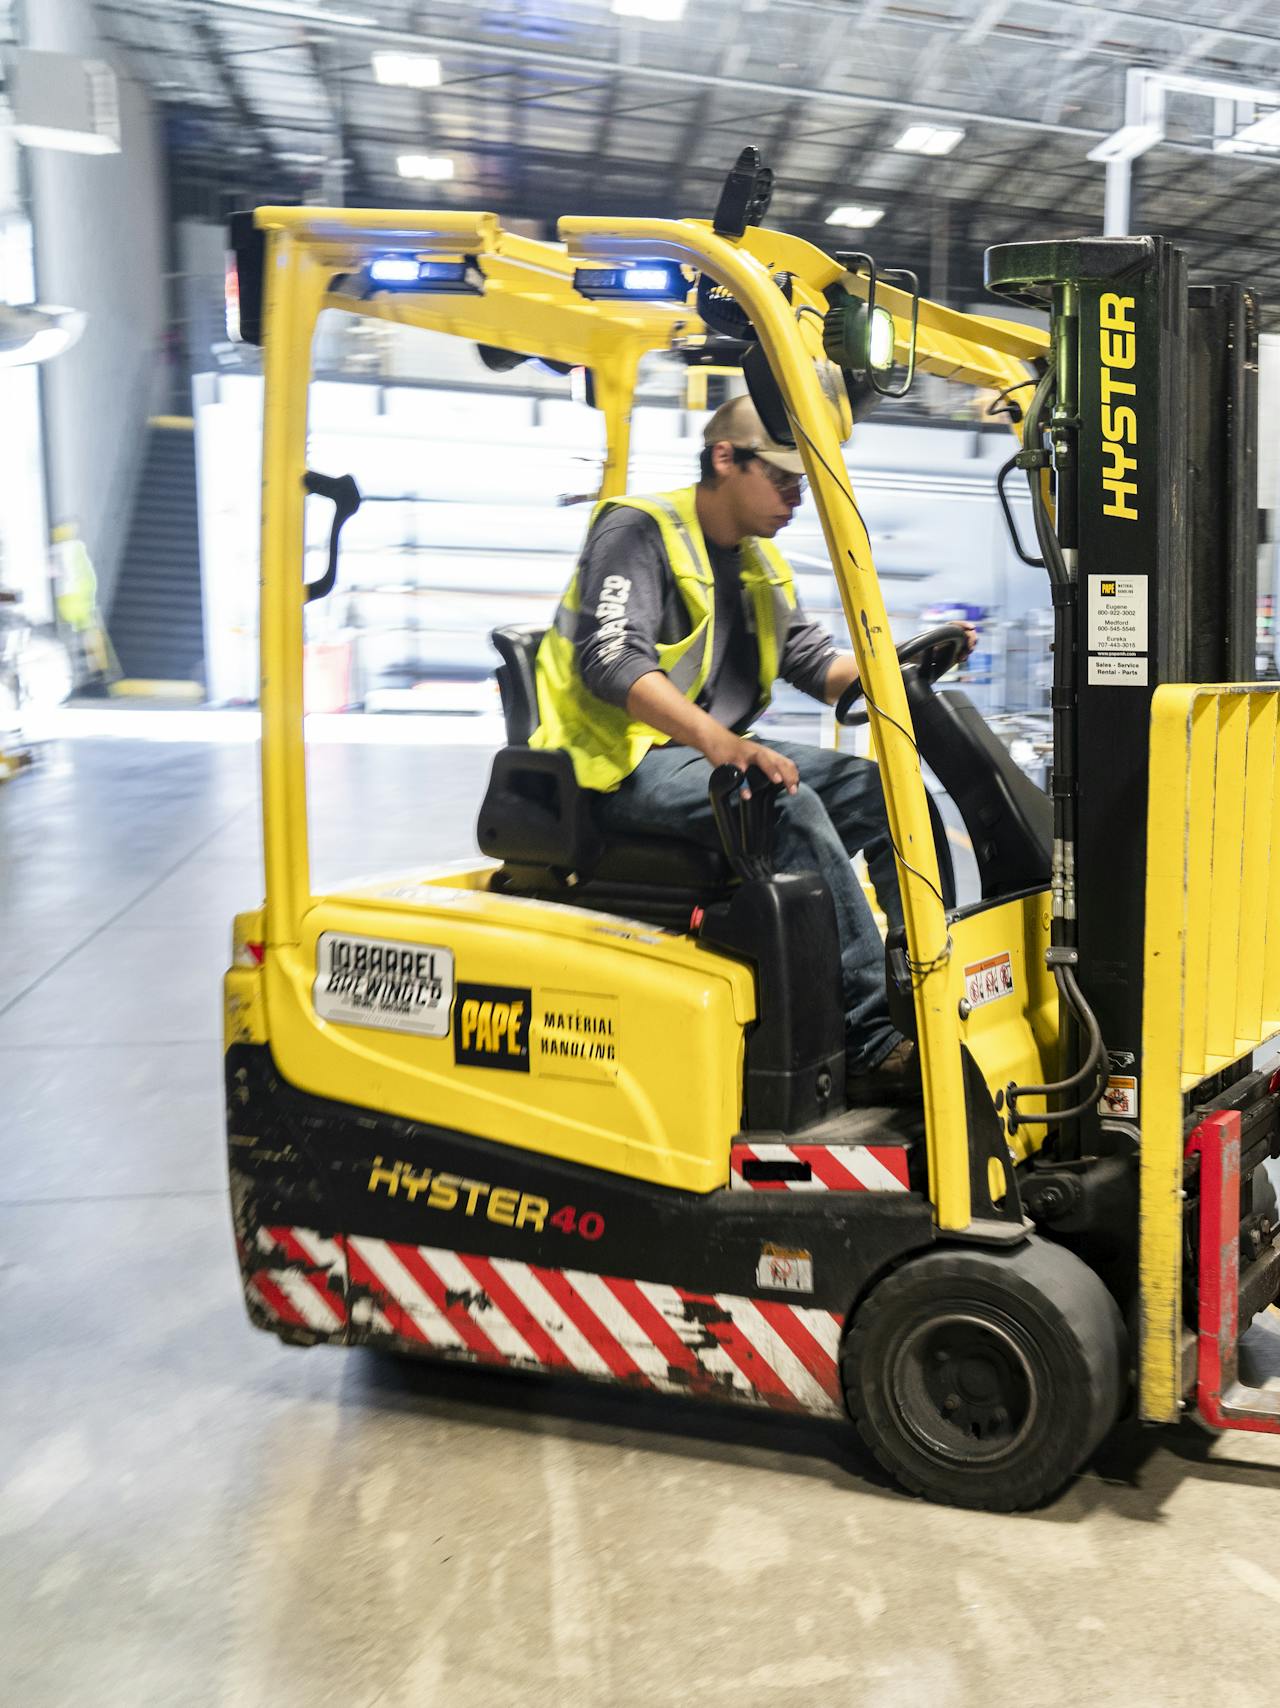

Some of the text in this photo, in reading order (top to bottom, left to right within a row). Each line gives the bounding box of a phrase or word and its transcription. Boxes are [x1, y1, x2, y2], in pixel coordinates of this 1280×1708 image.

[1100, 292, 1138, 520] HYSTER
[354, 945, 441, 982] BARREL
[544, 1011, 614, 1036] MATERIAL
[541, 1038, 615, 1060] HANDLING
[367, 1155, 606, 1241] HYSTER 40
